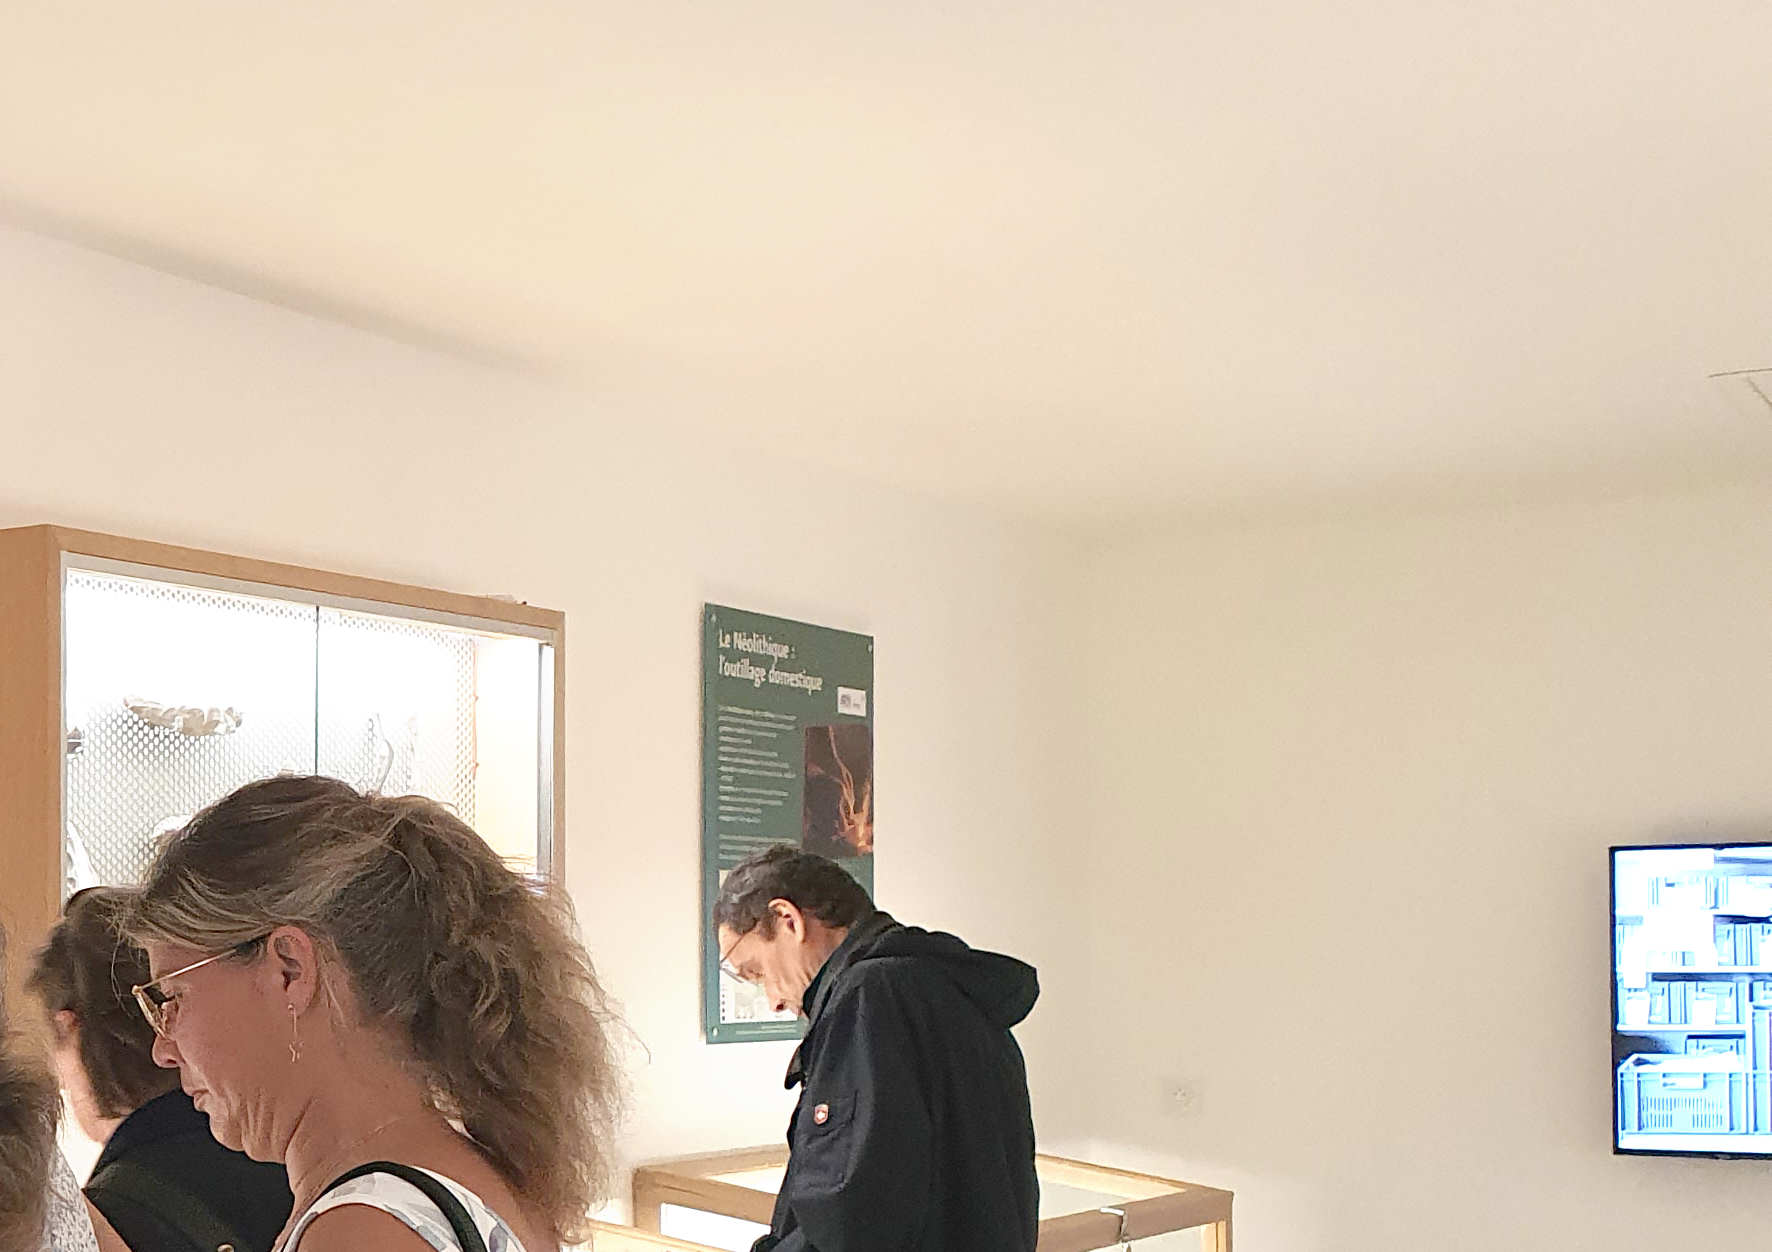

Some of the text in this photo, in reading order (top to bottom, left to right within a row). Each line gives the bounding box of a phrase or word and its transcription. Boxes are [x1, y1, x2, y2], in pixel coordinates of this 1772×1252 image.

[719, 628, 731, 649] Le
[733, 630, 790, 664] Néolithique
[718, 654, 824, 697] l'outillage domestique
